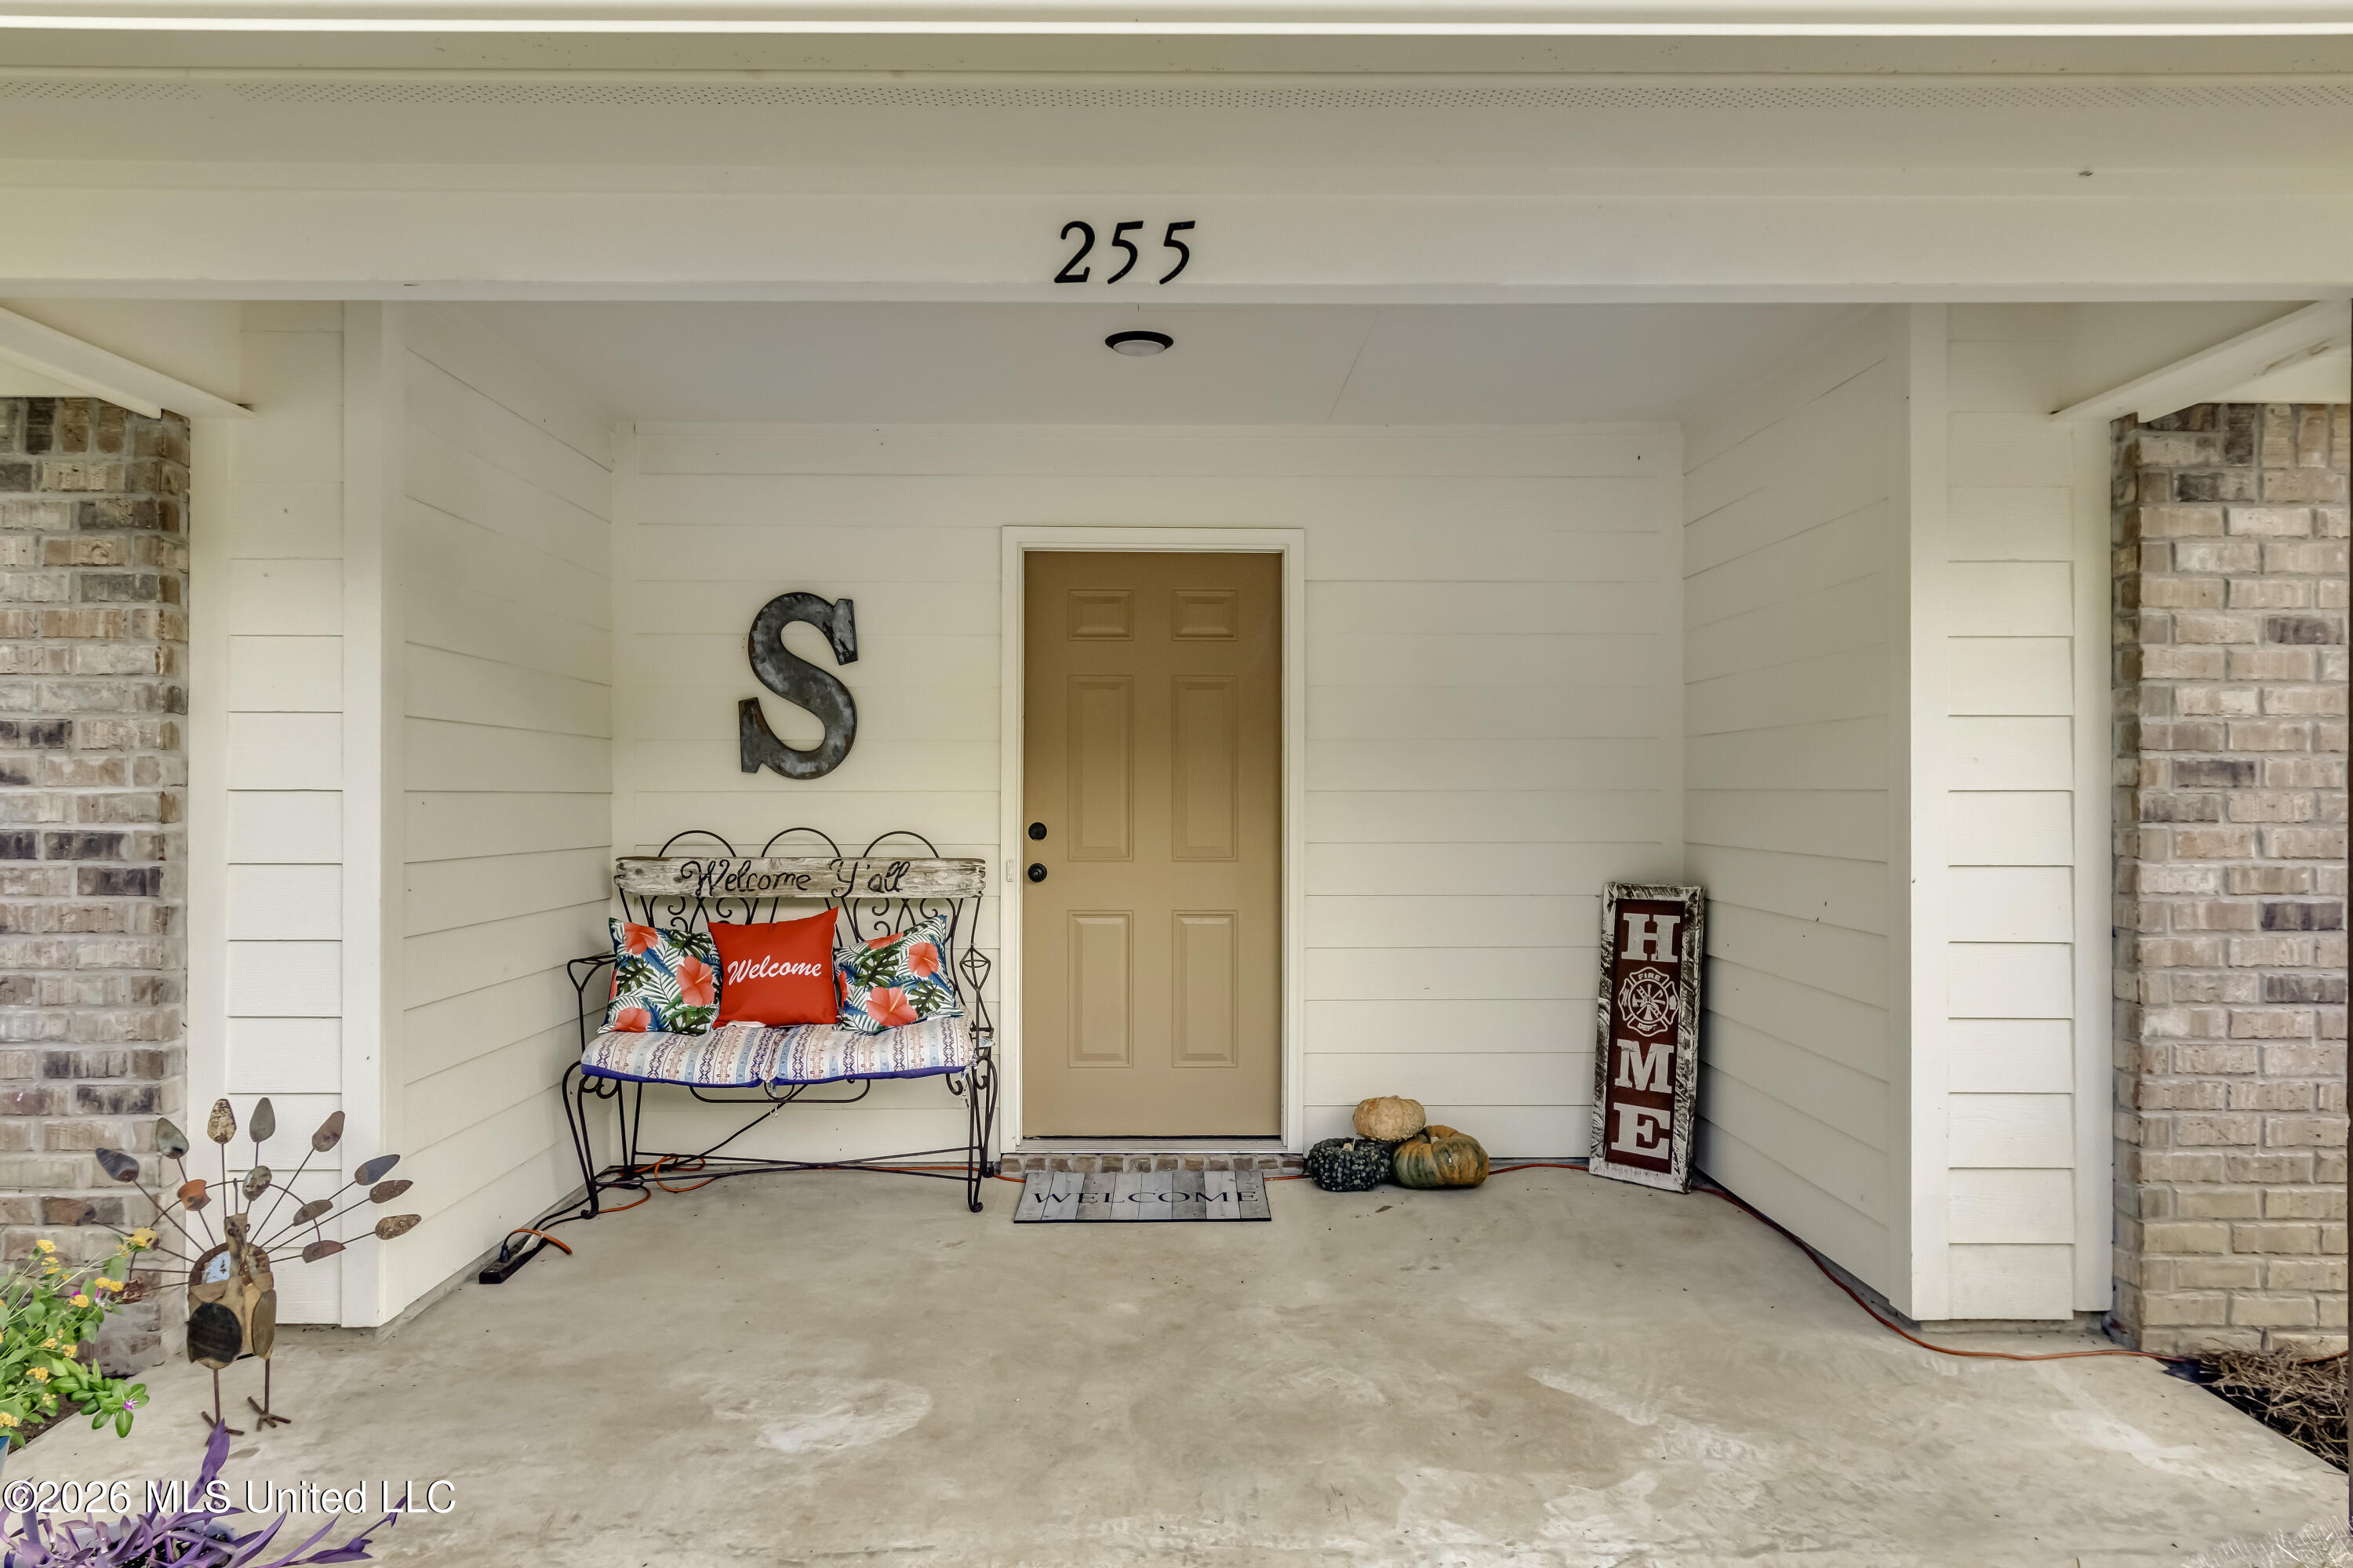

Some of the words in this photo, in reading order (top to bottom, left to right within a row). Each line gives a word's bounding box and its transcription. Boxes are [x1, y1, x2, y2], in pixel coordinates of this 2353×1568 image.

[1053, 220, 1196, 285] 255
[737, 591, 859, 780] S
[680, 859, 812, 897] Welcome
[829, 858, 911, 898] Y'all
[726, 954, 823, 987] Welcome
[1638, 972, 1662, 982] FIRE
[1031, 1191, 1259, 1204] WELCOME
